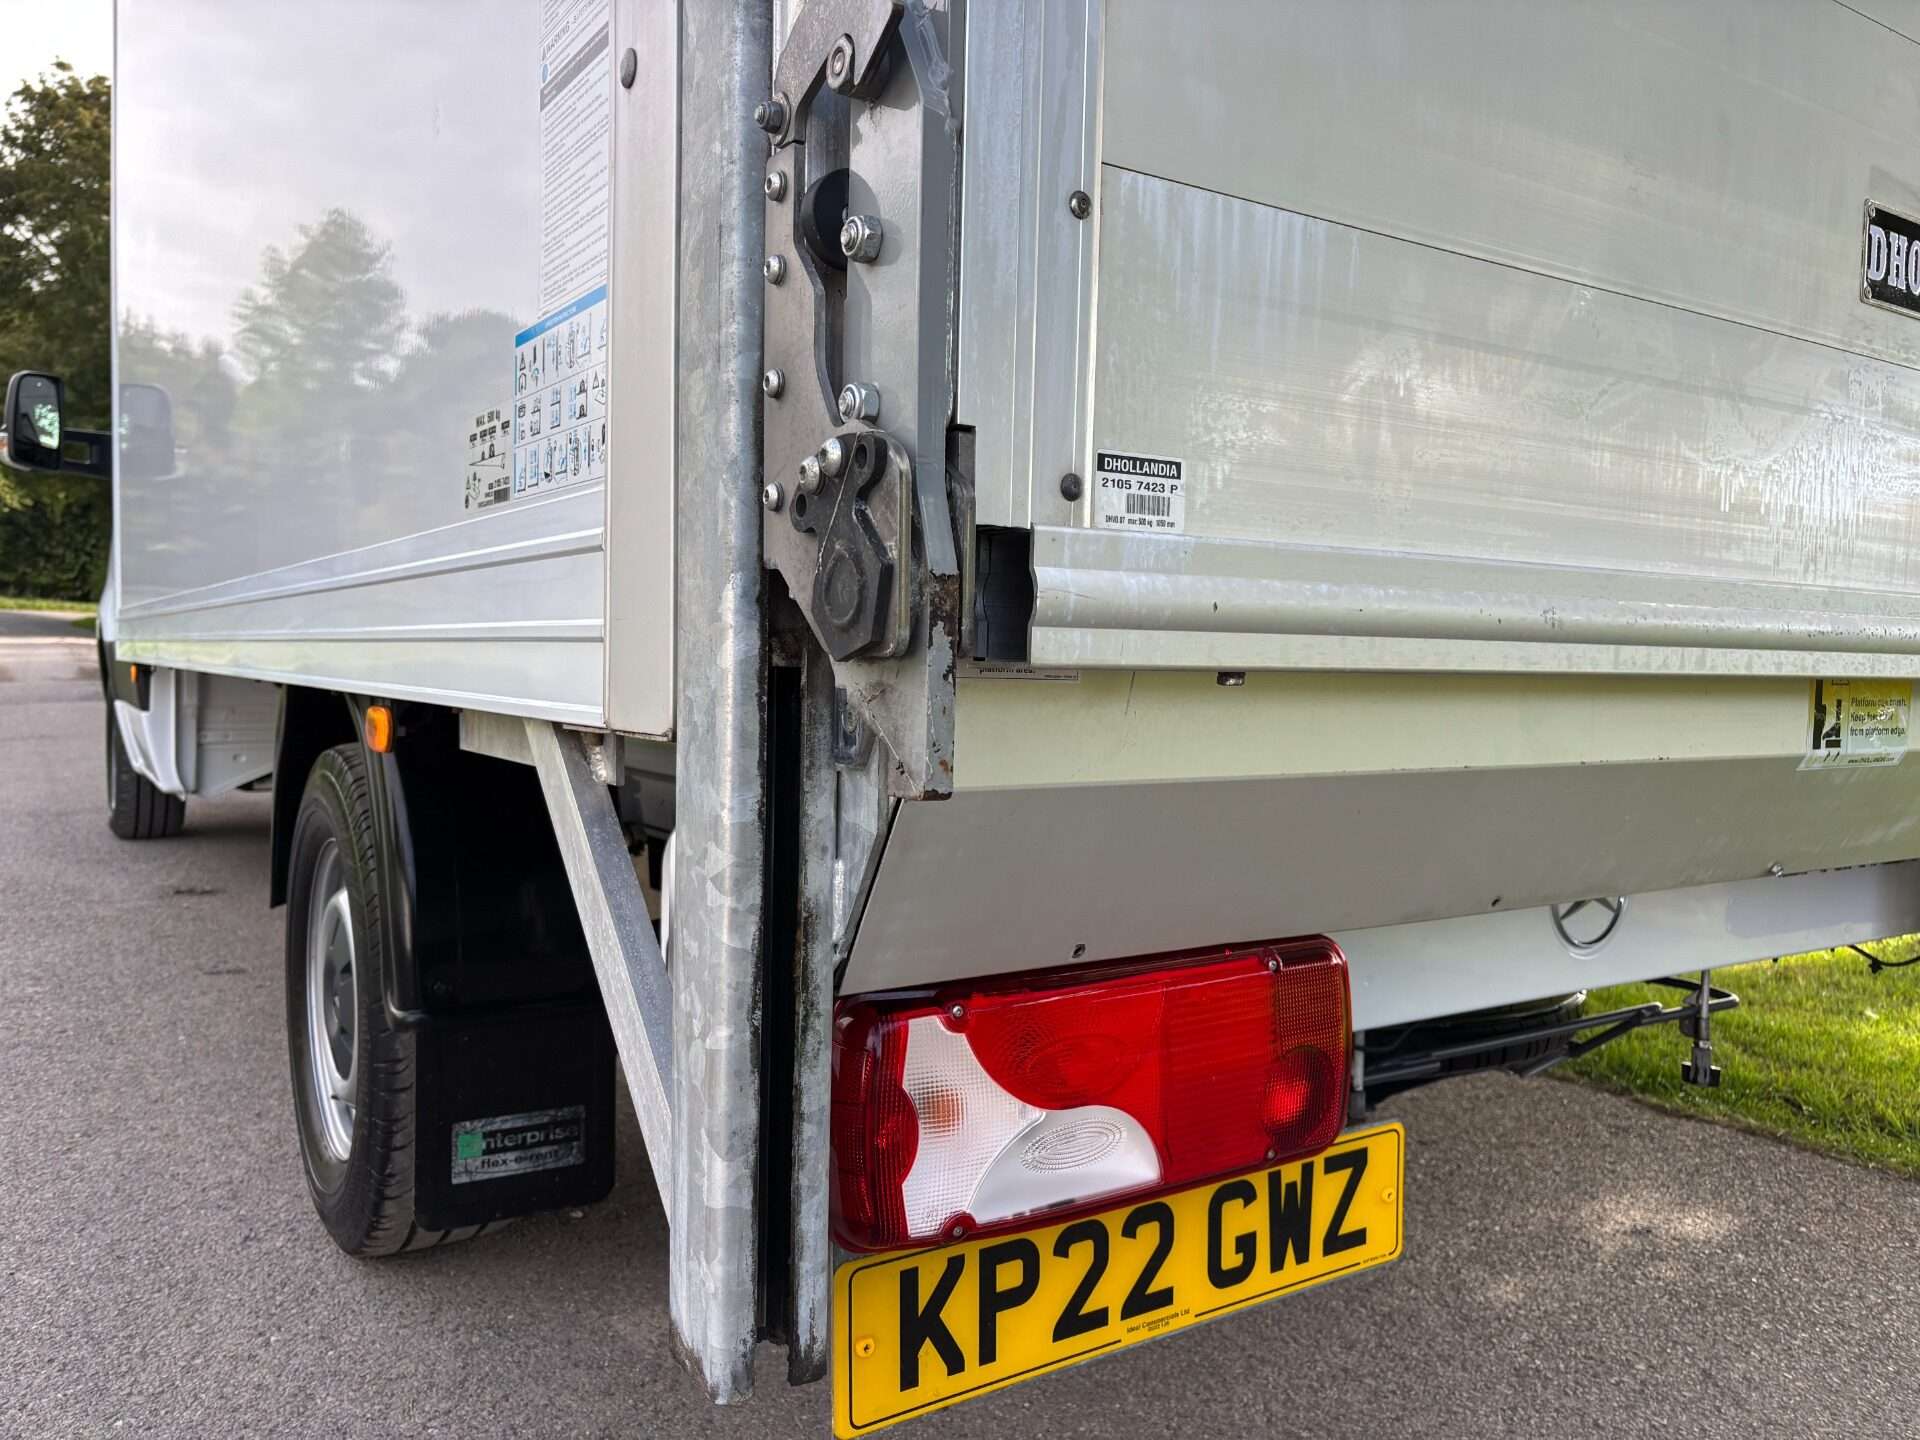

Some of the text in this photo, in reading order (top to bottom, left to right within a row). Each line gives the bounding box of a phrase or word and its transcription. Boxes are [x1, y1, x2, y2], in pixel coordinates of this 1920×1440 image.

[1104, 457, 1178, 477] DHOLLANDIA
[1101, 477, 1178, 494] 2105 7423 P
[1850, 712, 1866, 724] Keep
[462, 1124, 579, 1156] nterprise
[899, 1146, 1369, 1392] KP22 GWZ
